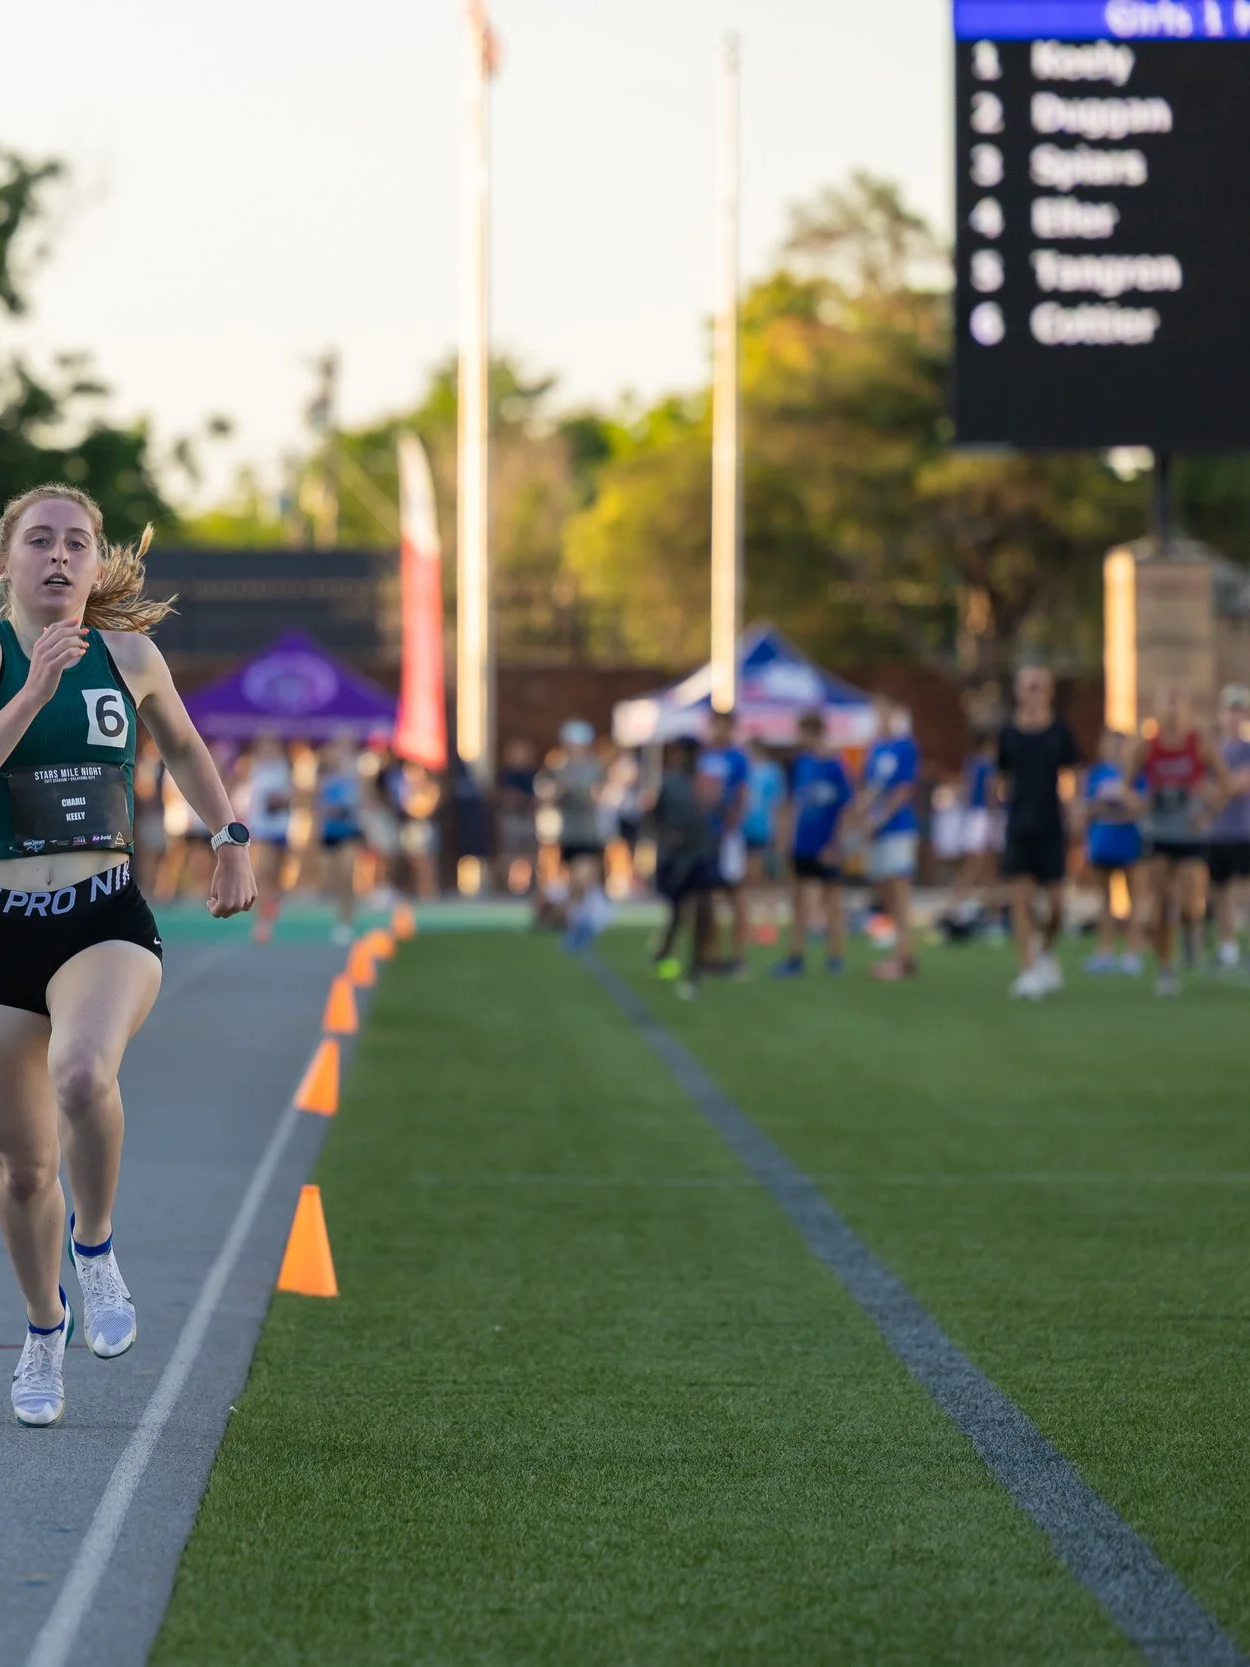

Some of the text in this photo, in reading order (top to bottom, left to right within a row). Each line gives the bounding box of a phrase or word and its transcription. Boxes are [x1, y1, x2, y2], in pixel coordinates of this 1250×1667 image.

[972, 40, 1135, 86] 1 Keely
[971, 92, 1173, 139] 2 Duggan
[971, 144, 1003, 187] 3
[970, 197, 1003, 238] 4
[971, 250, 1004, 292] 5
[970, 302, 1005, 345] 6
[95, 694, 125, 738] 6
[34, 767, 102, 781] STARS MILE NIGHT
[61, 797, 86, 807] CHARLI
[65, 812, 85, 822] KEELY
[3, 887, 77, 917] PRO
